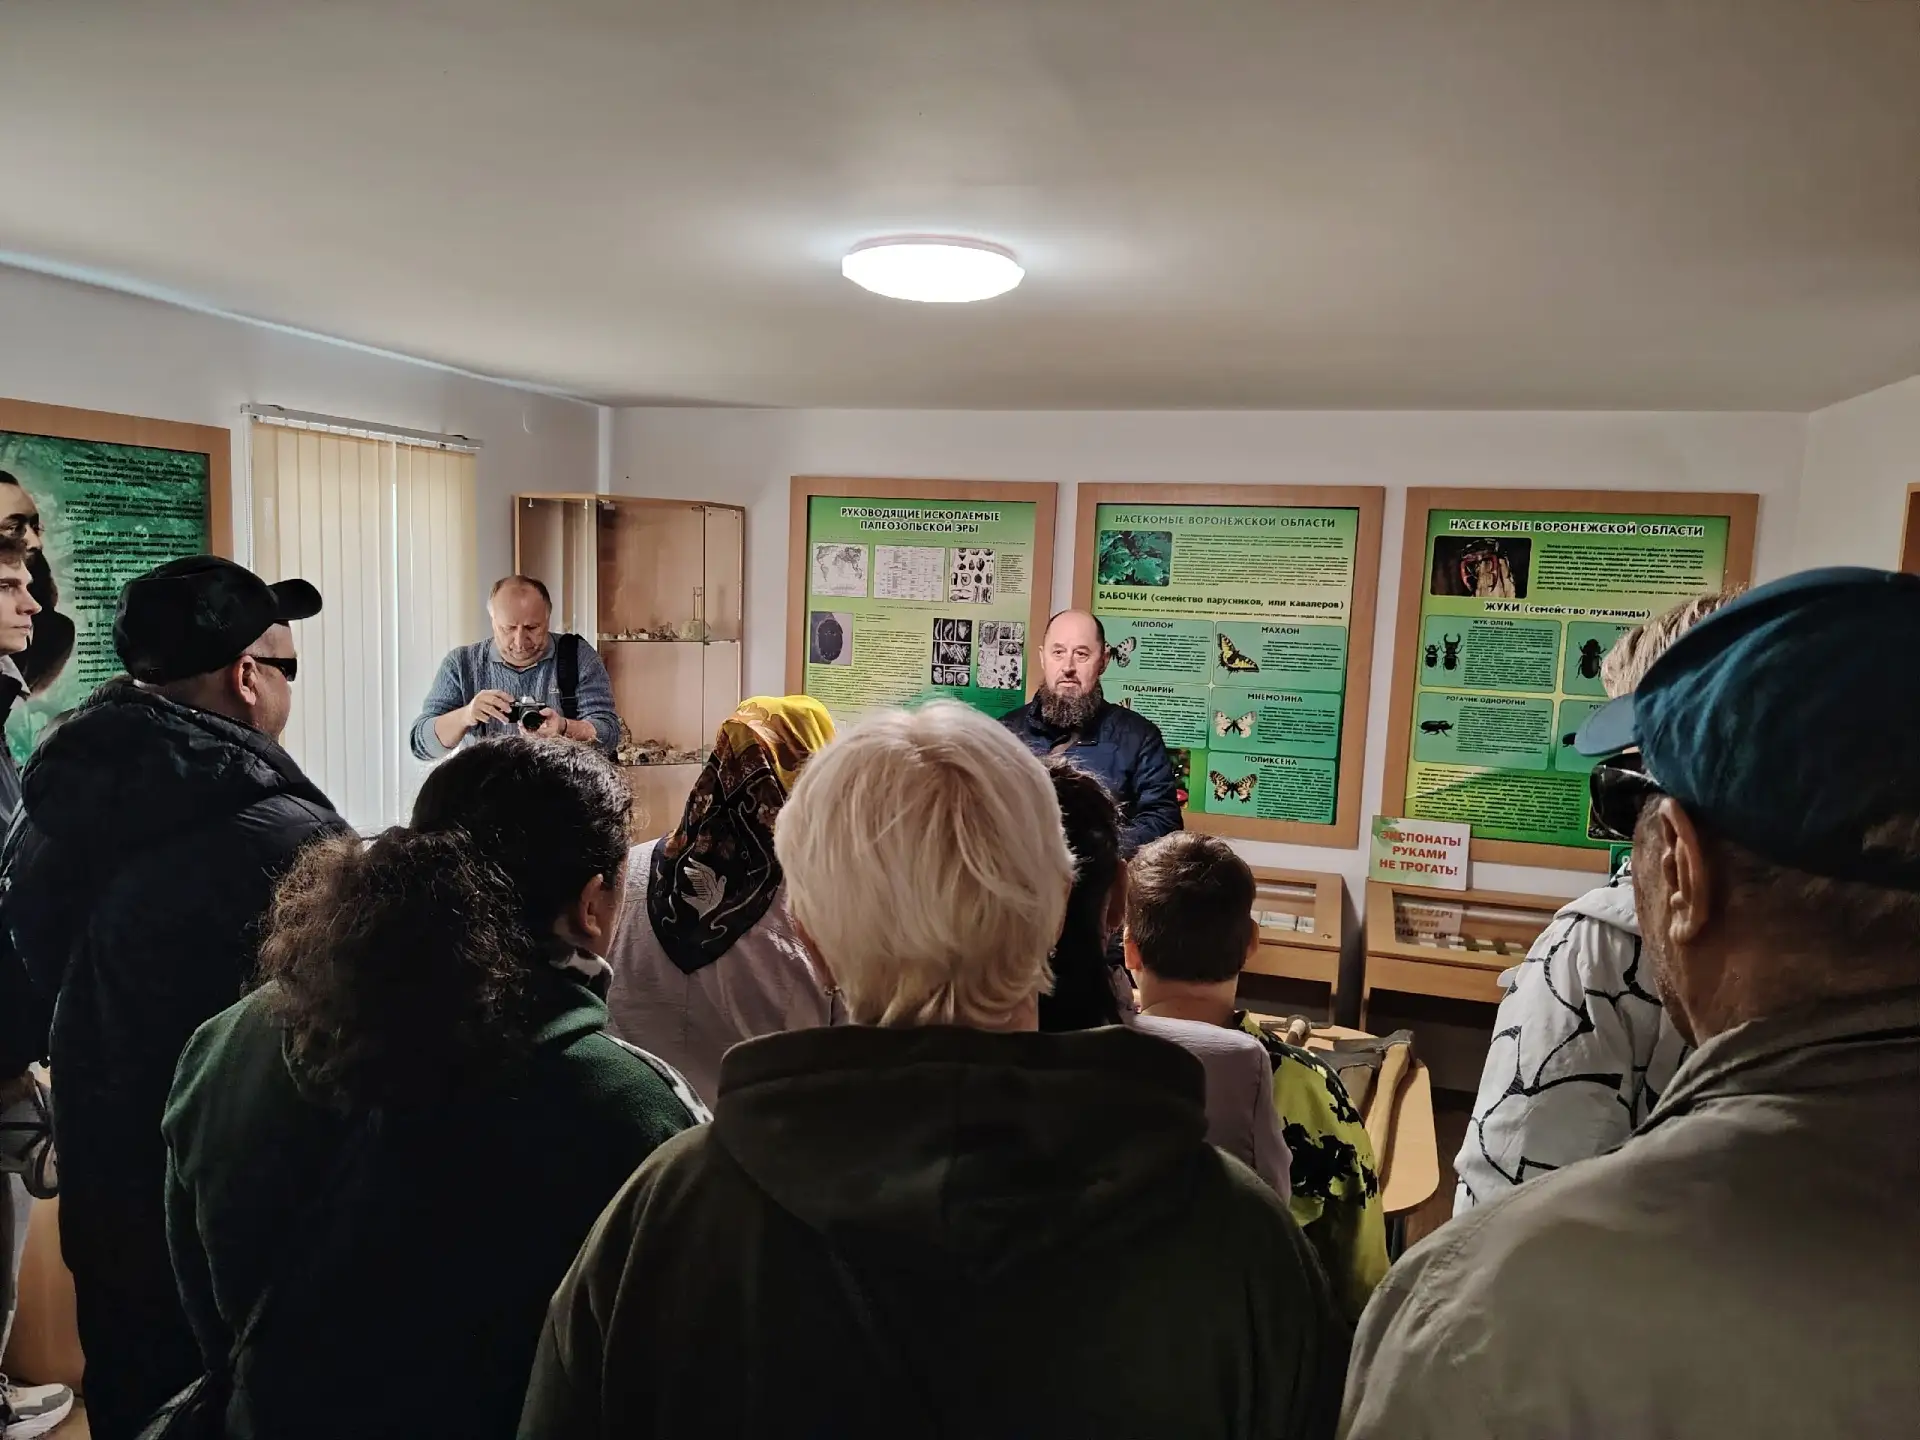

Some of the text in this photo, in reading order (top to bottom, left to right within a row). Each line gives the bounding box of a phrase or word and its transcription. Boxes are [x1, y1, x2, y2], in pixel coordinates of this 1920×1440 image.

[841, 507, 1000, 521] РУКОВОДЯЩИЕ ИСКОПАЕМЫЕ
[1115, 514, 1335, 528] НАСЕКОМЫЕ ВОРОНЕЖСКОЙ ОБЛАСТИ
[860, 520, 979, 533] ПАЛЕОЗОЛЬСКОЙ ЭРЫ
[1450, 519, 1704, 537] НАСЕКОМЫЕ ВОРОНЕЖСКОЙ ОБЛАСТИ
[1099, 591, 1148, 601] БАБОЧКИ
[1151, 593, 1203, 605] (семейство
[1206, 597, 1264, 608] парусников,
[1289, 600, 1344, 611] кавалеров)
[1485, 602, 1651, 619] ЖУКИ (семейство луканиды)
[1261, 626, 1300, 635] МАХАОН
[1247, 693, 1303, 702] МНЕМОЗИНА
[1244, 755, 1298, 766] ПОЛИКСЕНА
[1381, 830, 1461, 846] ЭКСПОНАТЫ
[1392, 846, 1447, 860] РУКАМИ
[1380, 859, 1458, 876] НЕ ТРОГАТЬ!
